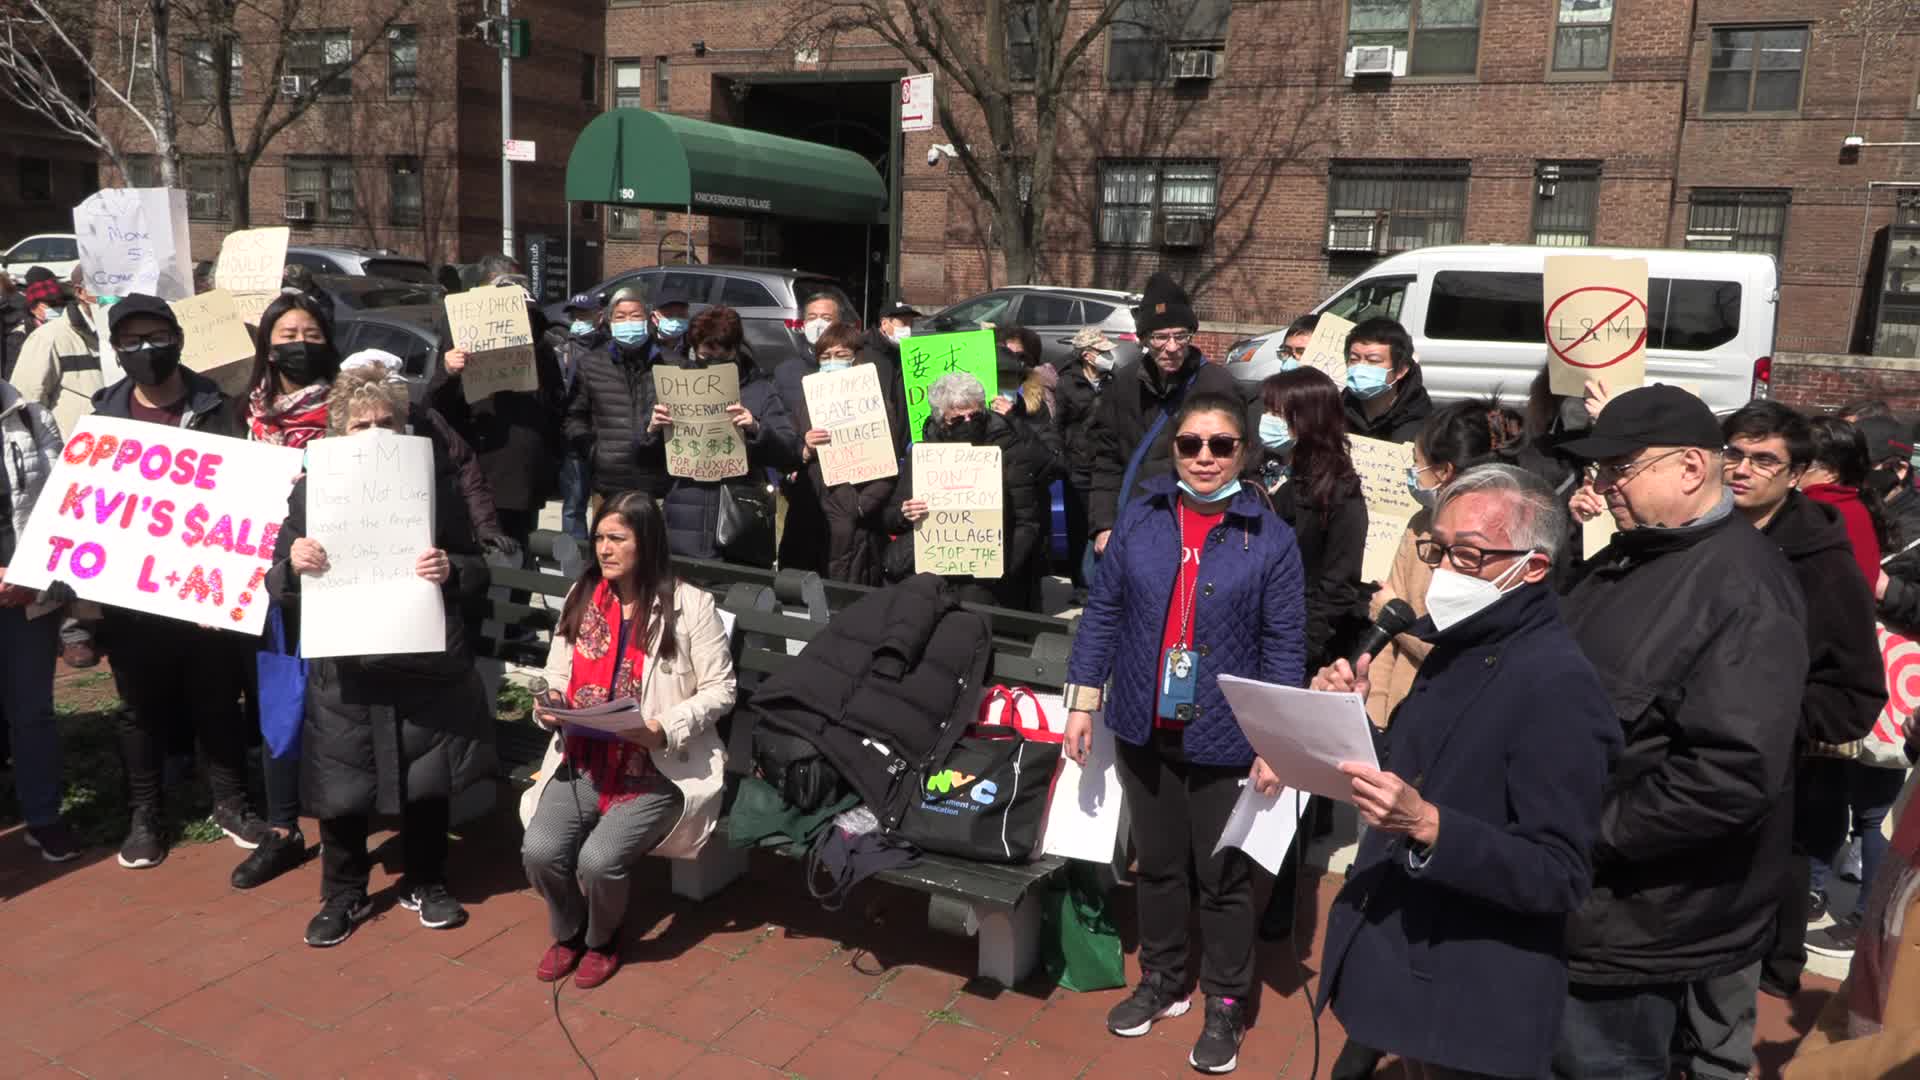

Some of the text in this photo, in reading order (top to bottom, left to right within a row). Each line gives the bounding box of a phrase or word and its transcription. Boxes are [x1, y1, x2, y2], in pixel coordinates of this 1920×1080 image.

[452, 300, 483, 320] HEY
[458, 320, 514, 340] DO THE
[1560, 315, 1631, 344] L&M
[908, 346, 971, 379] 要求
[660, 374, 726, 396] DHCR
[815, 395, 881, 421] SAVE OUR
[64, 431, 223, 490] OPPOSE
[670, 455, 690, 467] FOR
[916, 447, 946, 465] HEY
[926, 466, 984, 487] DON'T
[362, 480, 392, 504] Not
[920, 490, 998, 506] DESTROY
[59, 482, 175, 537] KVI'S
[936, 511, 976, 525] OUR
[920, 528, 1003, 546] VILLAGE!
[47, 536, 107, 579] TO
[924, 545, 999, 561] STOP THE
